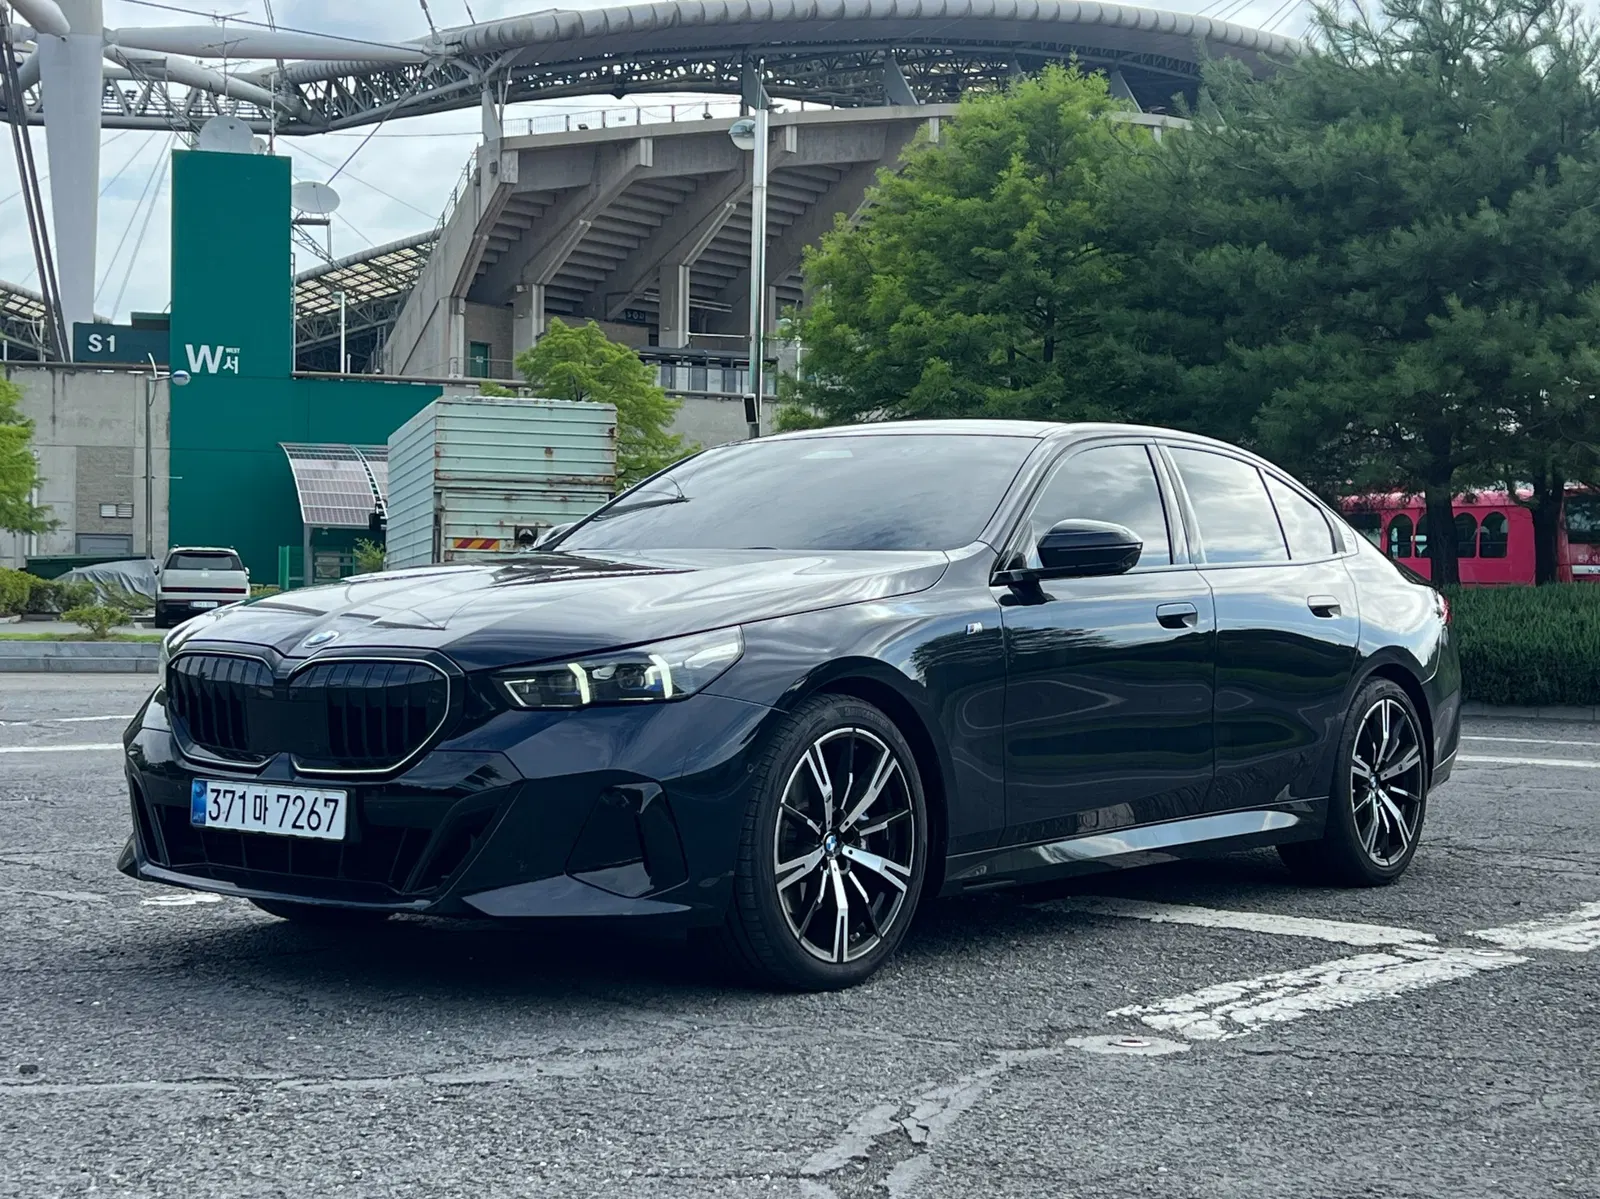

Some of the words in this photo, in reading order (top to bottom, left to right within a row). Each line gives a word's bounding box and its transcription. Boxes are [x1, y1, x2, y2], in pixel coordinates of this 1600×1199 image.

[88, 334, 116, 352] S1
[185, 344, 224, 374] W
[223, 355, 239, 374] 서
[208, 788, 269, 825] 371마
[276, 794, 339, 832] 7267
